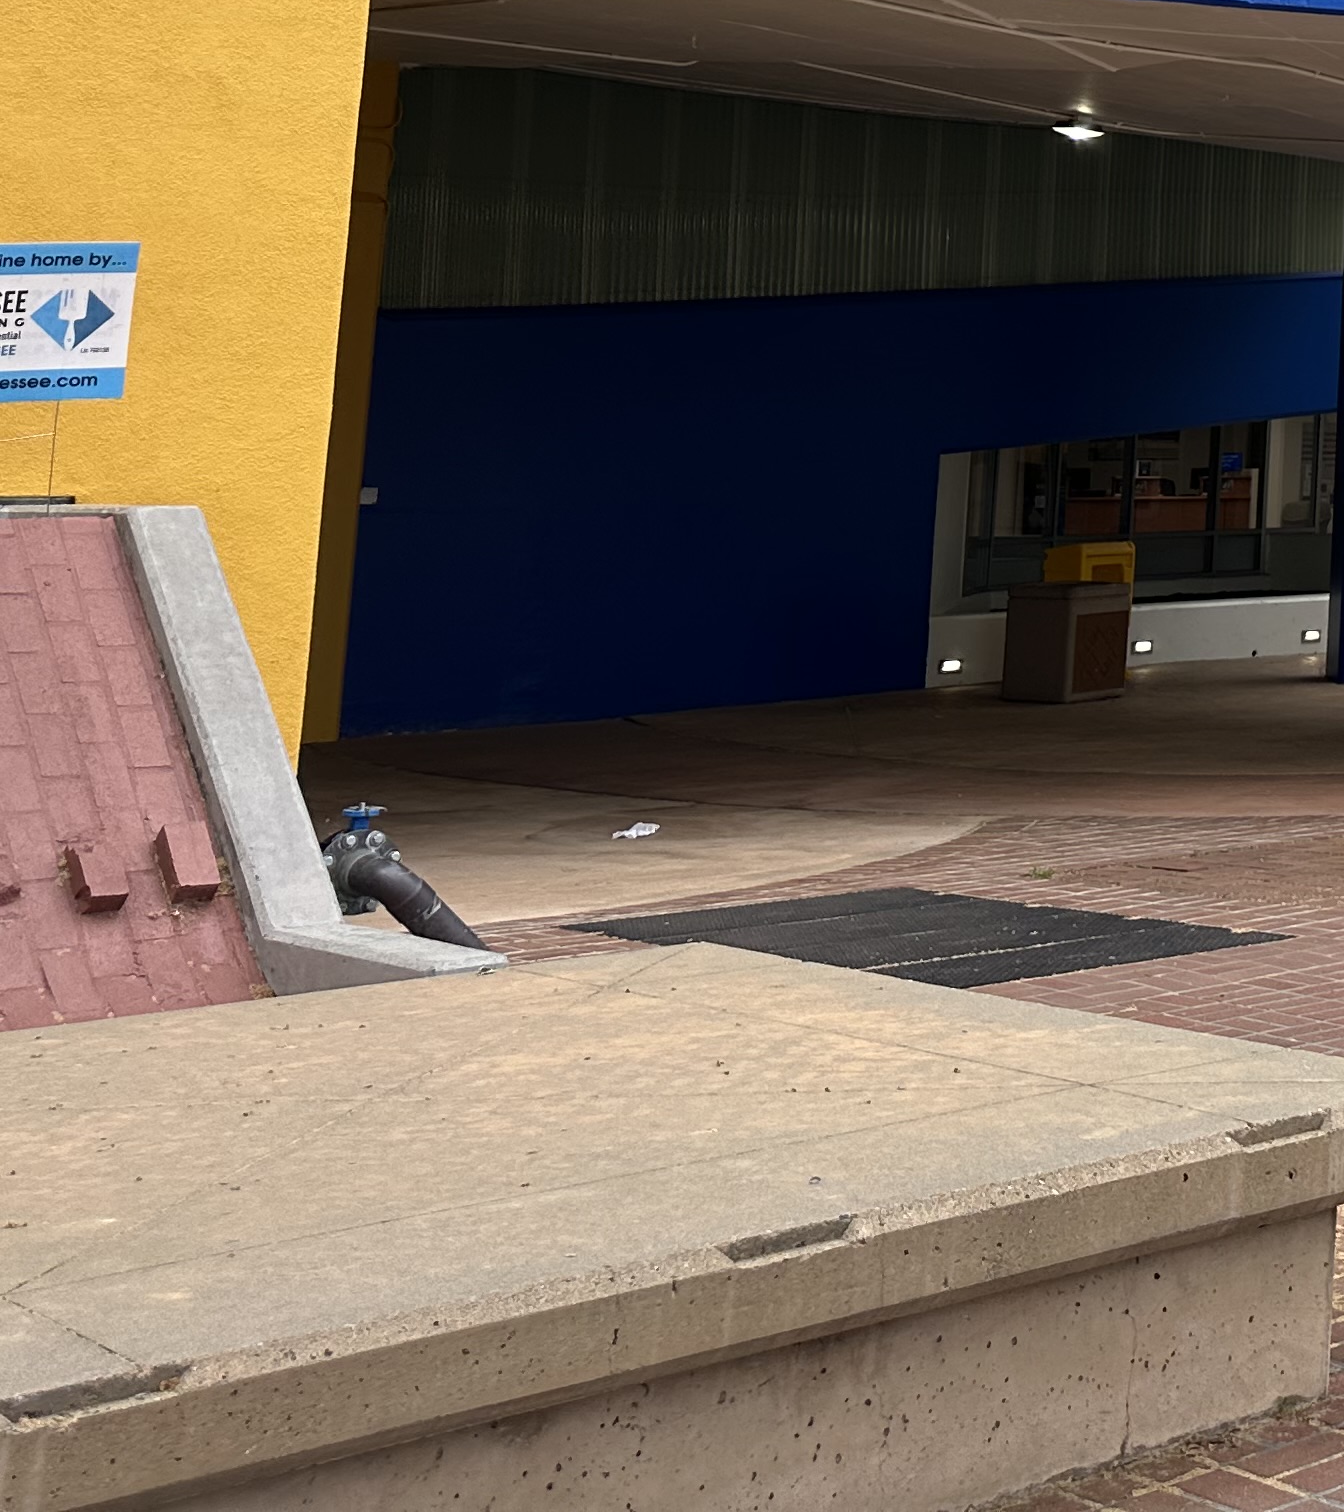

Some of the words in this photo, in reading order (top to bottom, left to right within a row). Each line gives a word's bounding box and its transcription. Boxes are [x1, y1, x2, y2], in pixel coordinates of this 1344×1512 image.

[31, 253, 84, 267] home
[88, 252, 127, 269] by...
[0, 289, 28, 313] EE
[0, 344, 17, 356] EE
[0, 375, 98, 389] essee.com
